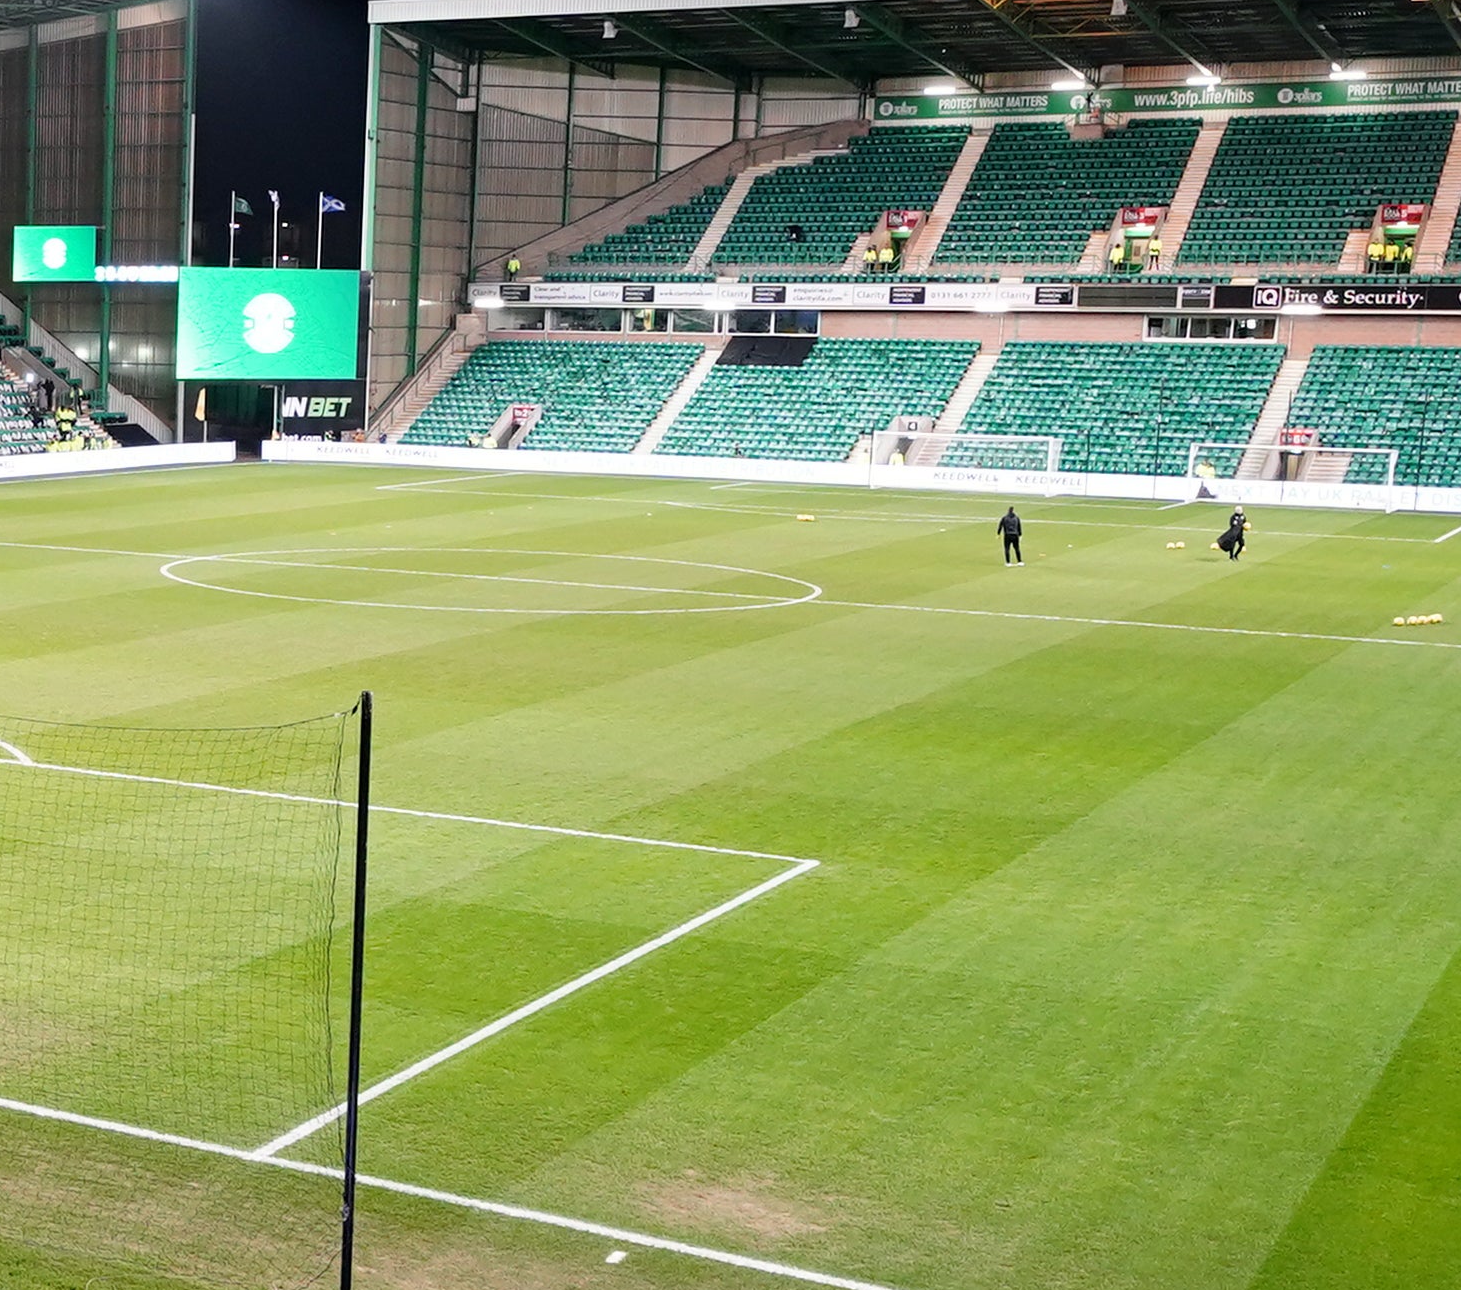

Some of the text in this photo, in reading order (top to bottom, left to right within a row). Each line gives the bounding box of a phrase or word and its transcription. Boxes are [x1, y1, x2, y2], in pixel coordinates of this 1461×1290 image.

[1347, 84, 1393, 96] PROTECT
[1395, 82, 1425, 94] WHAT
[939, 97, 977, 110] PROTECT
[979, 97, 1004, 109] WHAT
[1007, 95, 1048, 108] MATTERS
[593, 289, 619, 300] Clarity
[721, 289, 749, 301] Clarity
[856, 290, 886, 301] Clarity
[999, 290, 1032, 302] Clarity
[1283, 287, 1318, 304] Fire
[1321, 289, 1338, 304] &
[1343, 289, 1421, 309] Security
[1015, 475, 1082, 487] KEEDWELL
